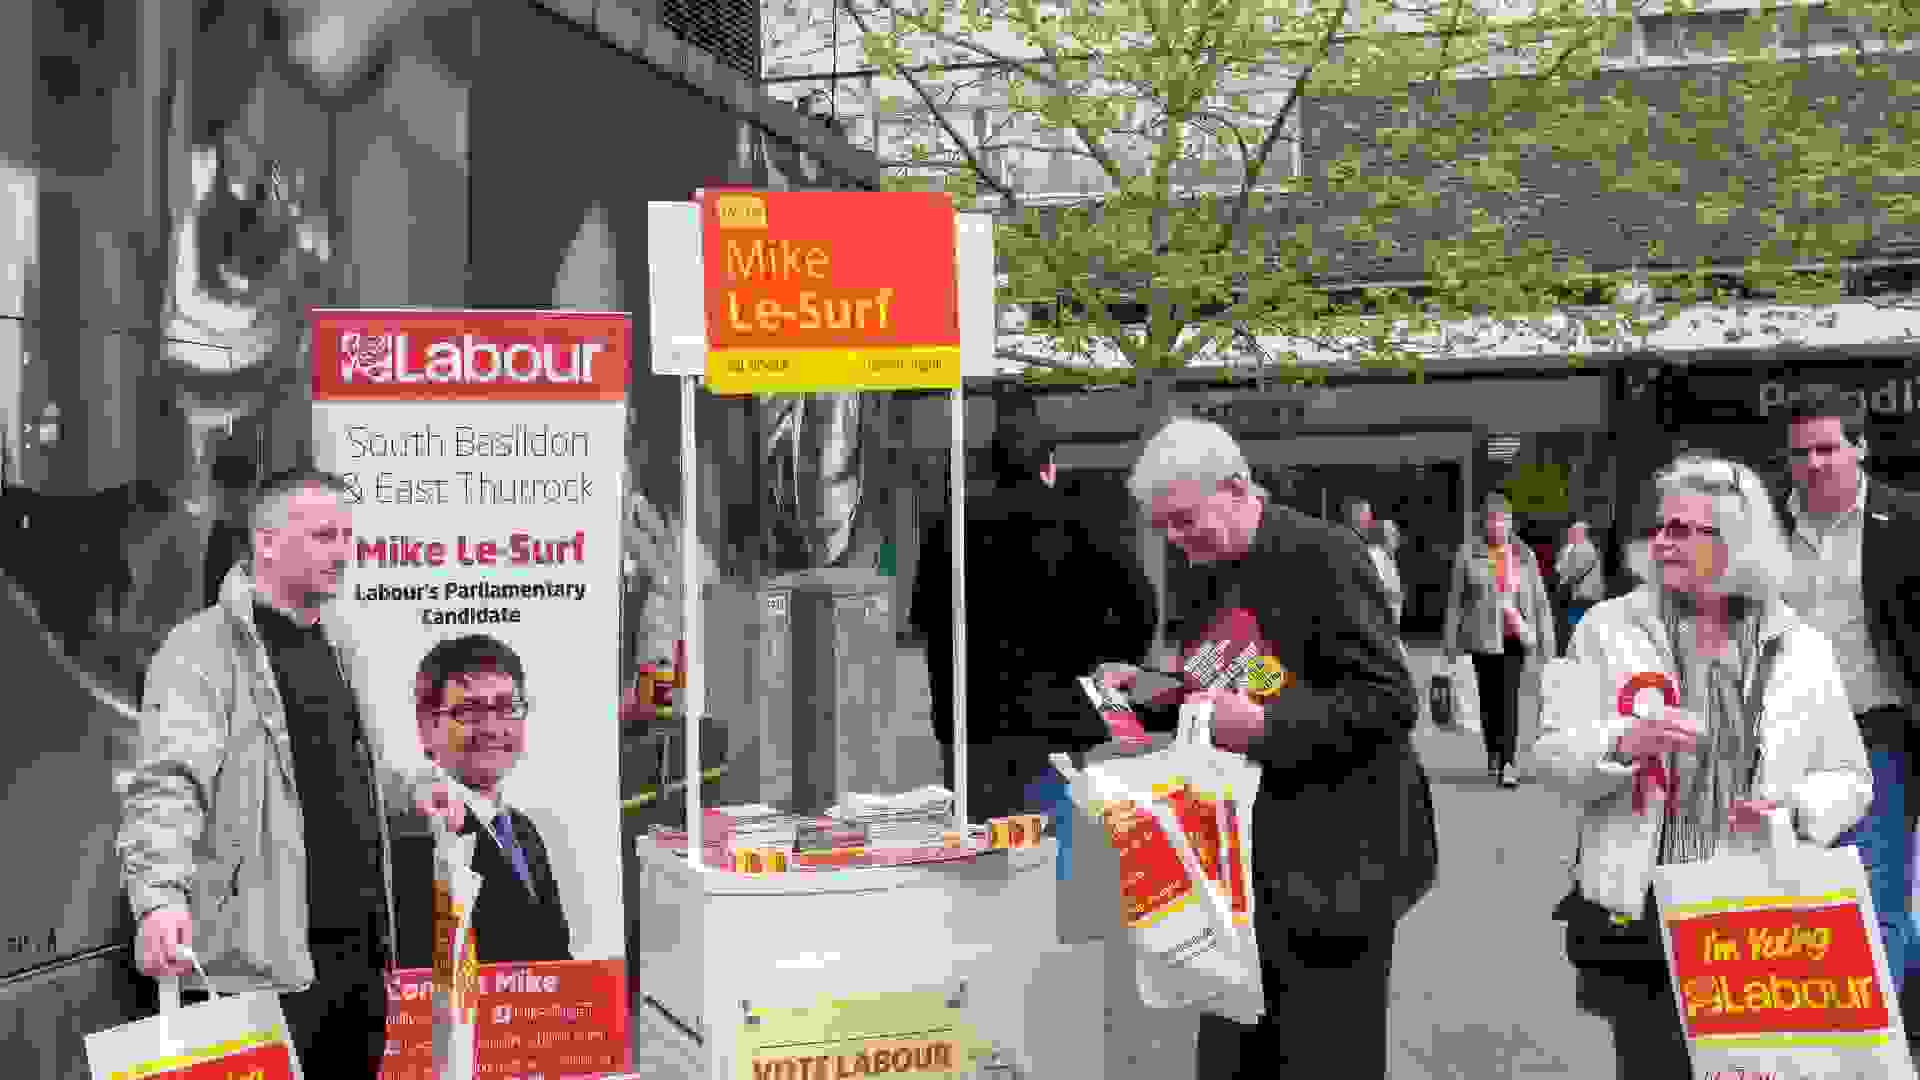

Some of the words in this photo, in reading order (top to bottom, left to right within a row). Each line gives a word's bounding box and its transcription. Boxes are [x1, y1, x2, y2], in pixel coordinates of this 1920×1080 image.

[727, 239, 830, 281] Mike
[727, 287, 893, 331] Le-Surf
[392, 331, 606, 384] Labour
[346, 424, 447, 458] South
[456, 424, 590, 457] Basildon
[375, 471, 449, 505] East
[456, 471, 593, 505] Thurrock
[354, 534, 449, 568] Mike
[456, 530, 586, 568] Le-Surf
[354, 582, 440, 602] Labour's
[446, 581, 586, 603] Parliamentary
[420, 607, 522, 626] Candidate
[494, 967, 560, 993] Mike
[1722, 974, 1874, 1016] Labour
[836, 1042, 952, 1078] LABOUR
